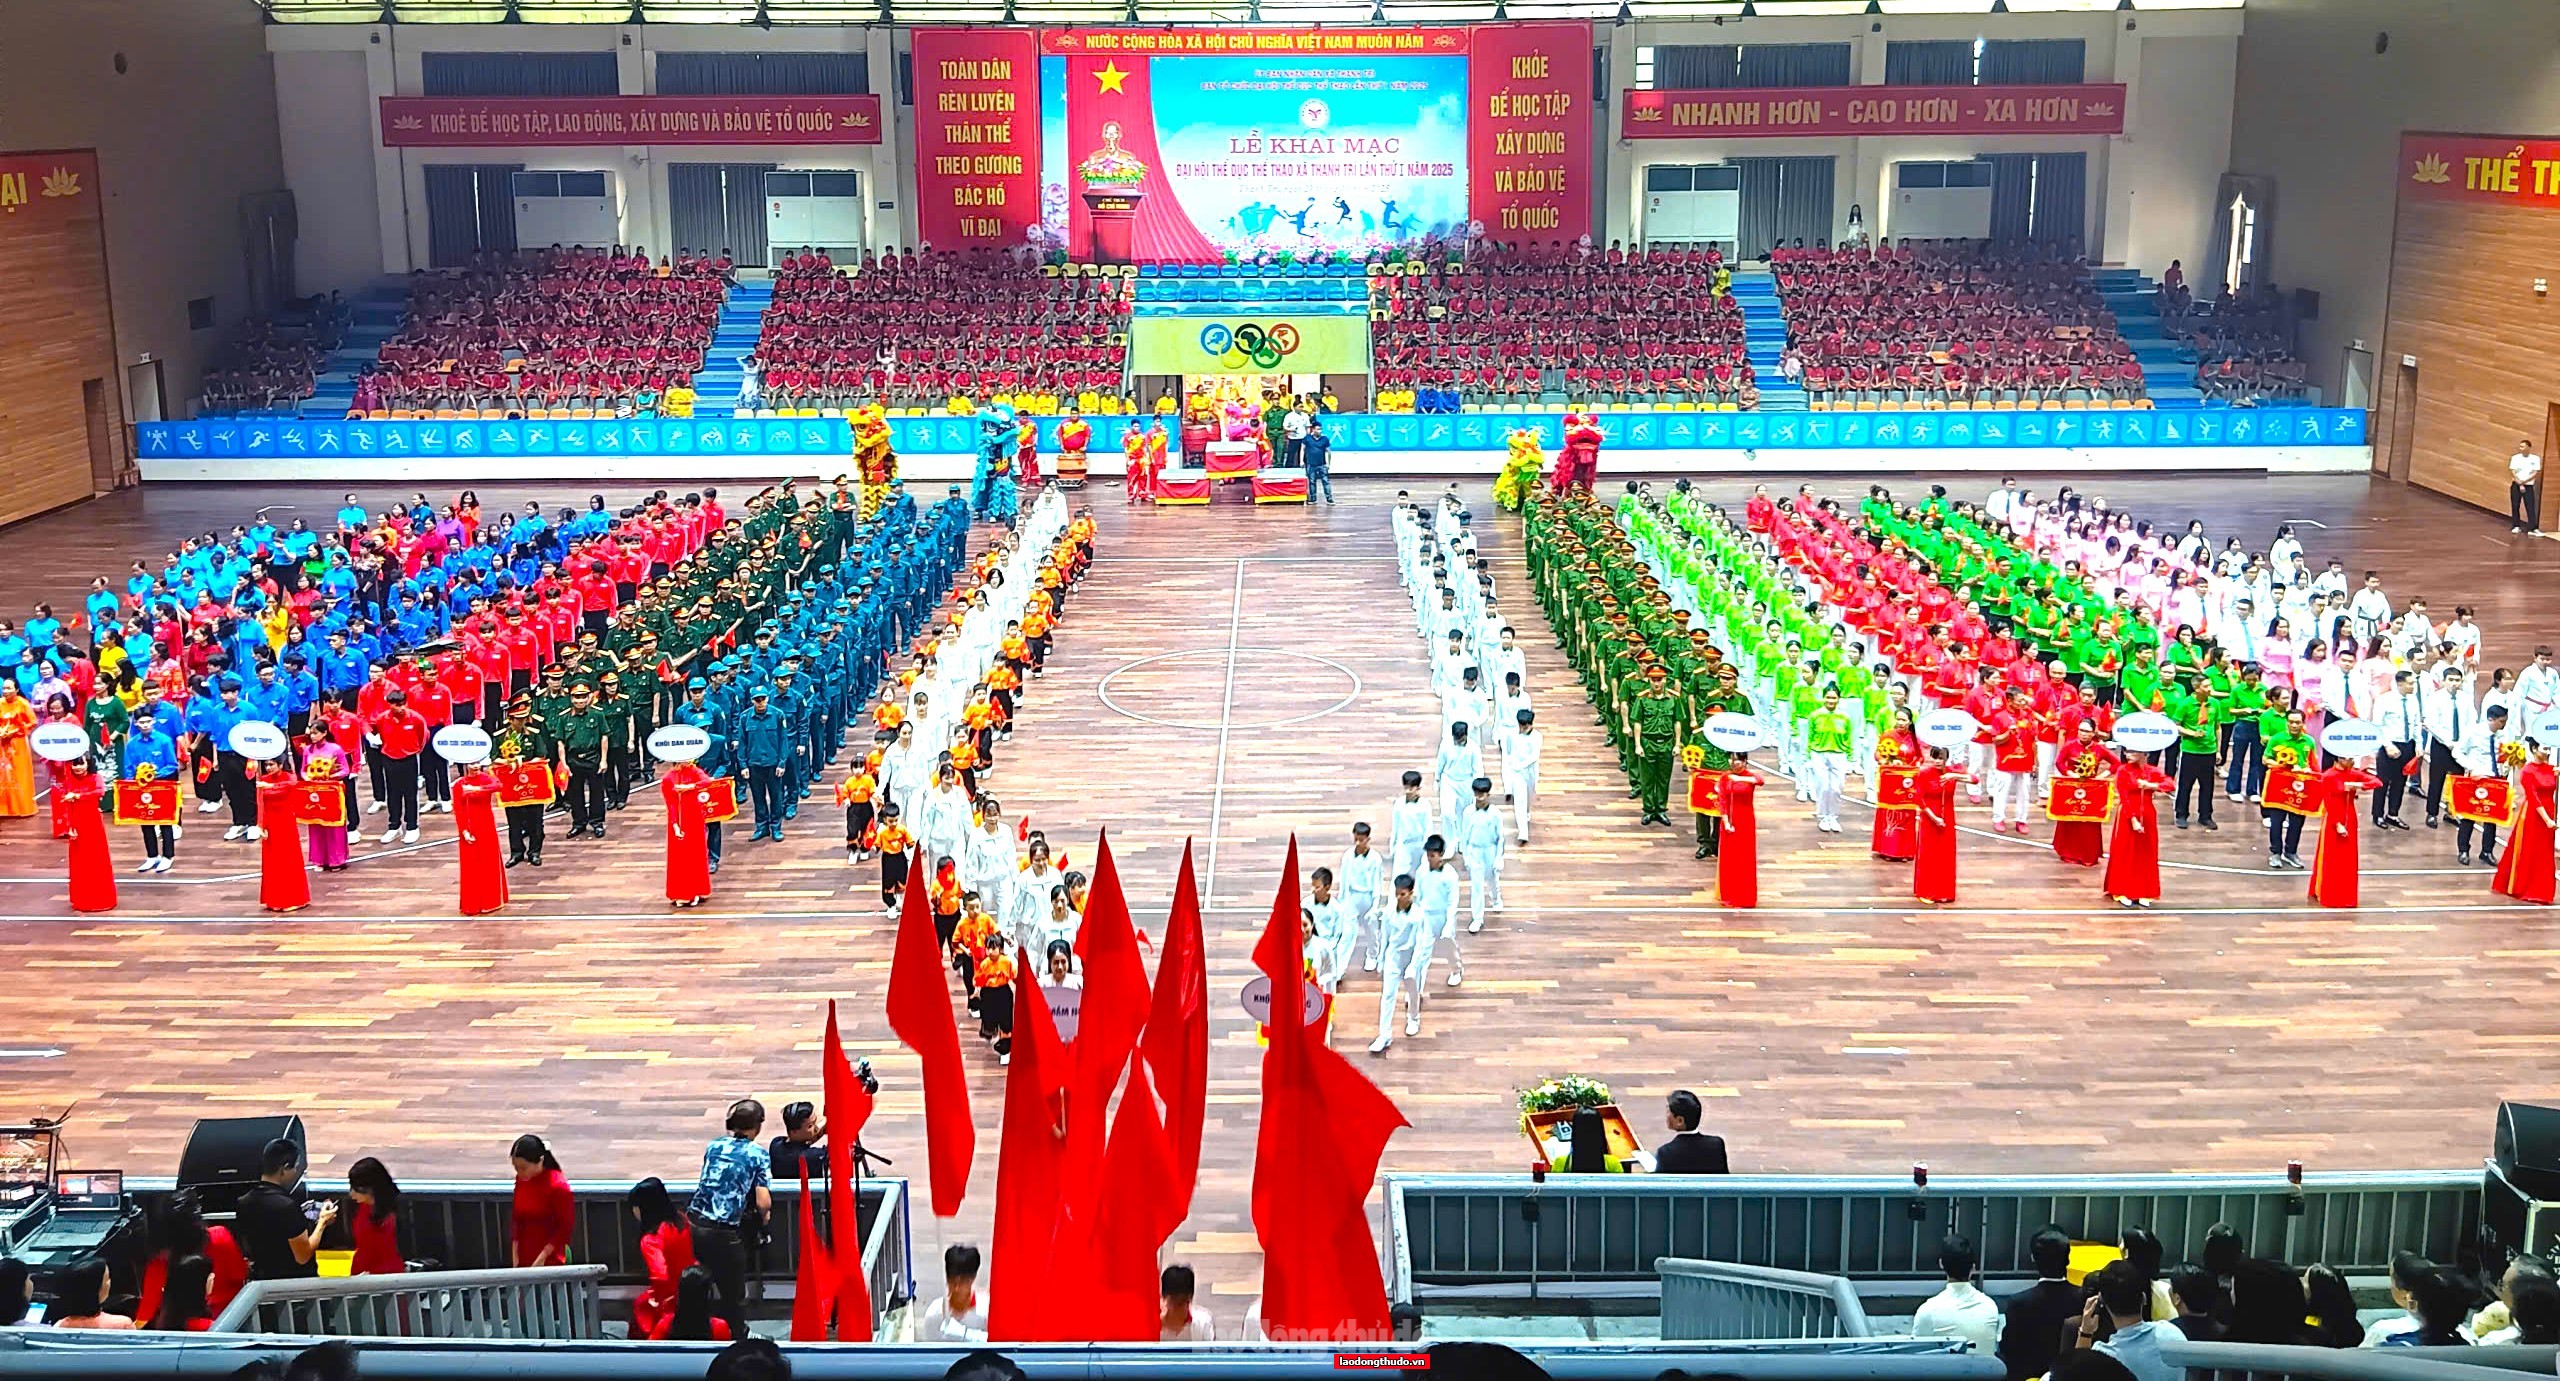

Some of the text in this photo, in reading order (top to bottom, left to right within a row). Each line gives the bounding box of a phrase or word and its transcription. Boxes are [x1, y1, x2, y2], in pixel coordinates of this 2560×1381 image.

[1086, 32, 1424, 51] NƯỚC CỘNG HÒA XÃ HỘI CHỦ NGHĨA VIỆT NAM MUÔN NĂM
[940, 56, 1011, 80] TOÀN DÂN
[1512, 48, 1549, 79] KHỎE
[938, 88, 1015, 115] RÈN LUYỆN
[1490, 85, 1571, 122] ĐỂ HỌC TẬP
[1672, 102, 1760, 126] NHANH
[1768, 99, 1821, 125] HƠN
[1847, 100, 1897, 124] CAO
[1904, 97, 1958, 123] HƠN
[1984, 98, 2016, 122] XA
[2024, 96, 2079, 122] HƠN
[470, 105, 489, 133] ĐỂ
[492, 113, 521, 136] HỌC
[524, 109, 552, 136] TẬP,
[555, 113, 580, 133] LAO
[583, 109, 627, 136] ĐỘNG,
[630, 108, 657, 132] XÂY
[660, 110, 699, 136] DỰNG
[702, 107, 720, 131] VÀ
[724, 105, 751, 131] BẢO
[755, 108, 772, 136] VỆ
[775, 104, 793, 131] TỔ
[796, 105, 833, 133] QUỐC
[945, 117, 1011, 143] THÂN THỂ
[1230, 129, 1400, 157] LỄ KHAI MẠC
[1495, 128, 1565, 159] XÂY DỰNG
[936, 154, 1022, 175] THEO GƯƠNG
[1194, 161, 1209, 180] HỘI
[1231, 164, 1249, 180] DỤC
[1271, 163, 1293, 177] THAO
[1311, 163, 1340, 177] THANH
[1407, 161, 1428, 177] NĂM
[1431, 163, 1453, 177] 2025
[2464, 145, 2525, 192] THỂ
[1495, 163, 1566, 196] VÀ BẢO VỆ
[954, 181, 1005, 206] BÁC HỒ
[960, 215, 1001, 240] VĨ ĐẠI
[1501, 199, 1559, 231] TỔ QUỐC
[1253, 993, 1270, 1004] KHỐ
